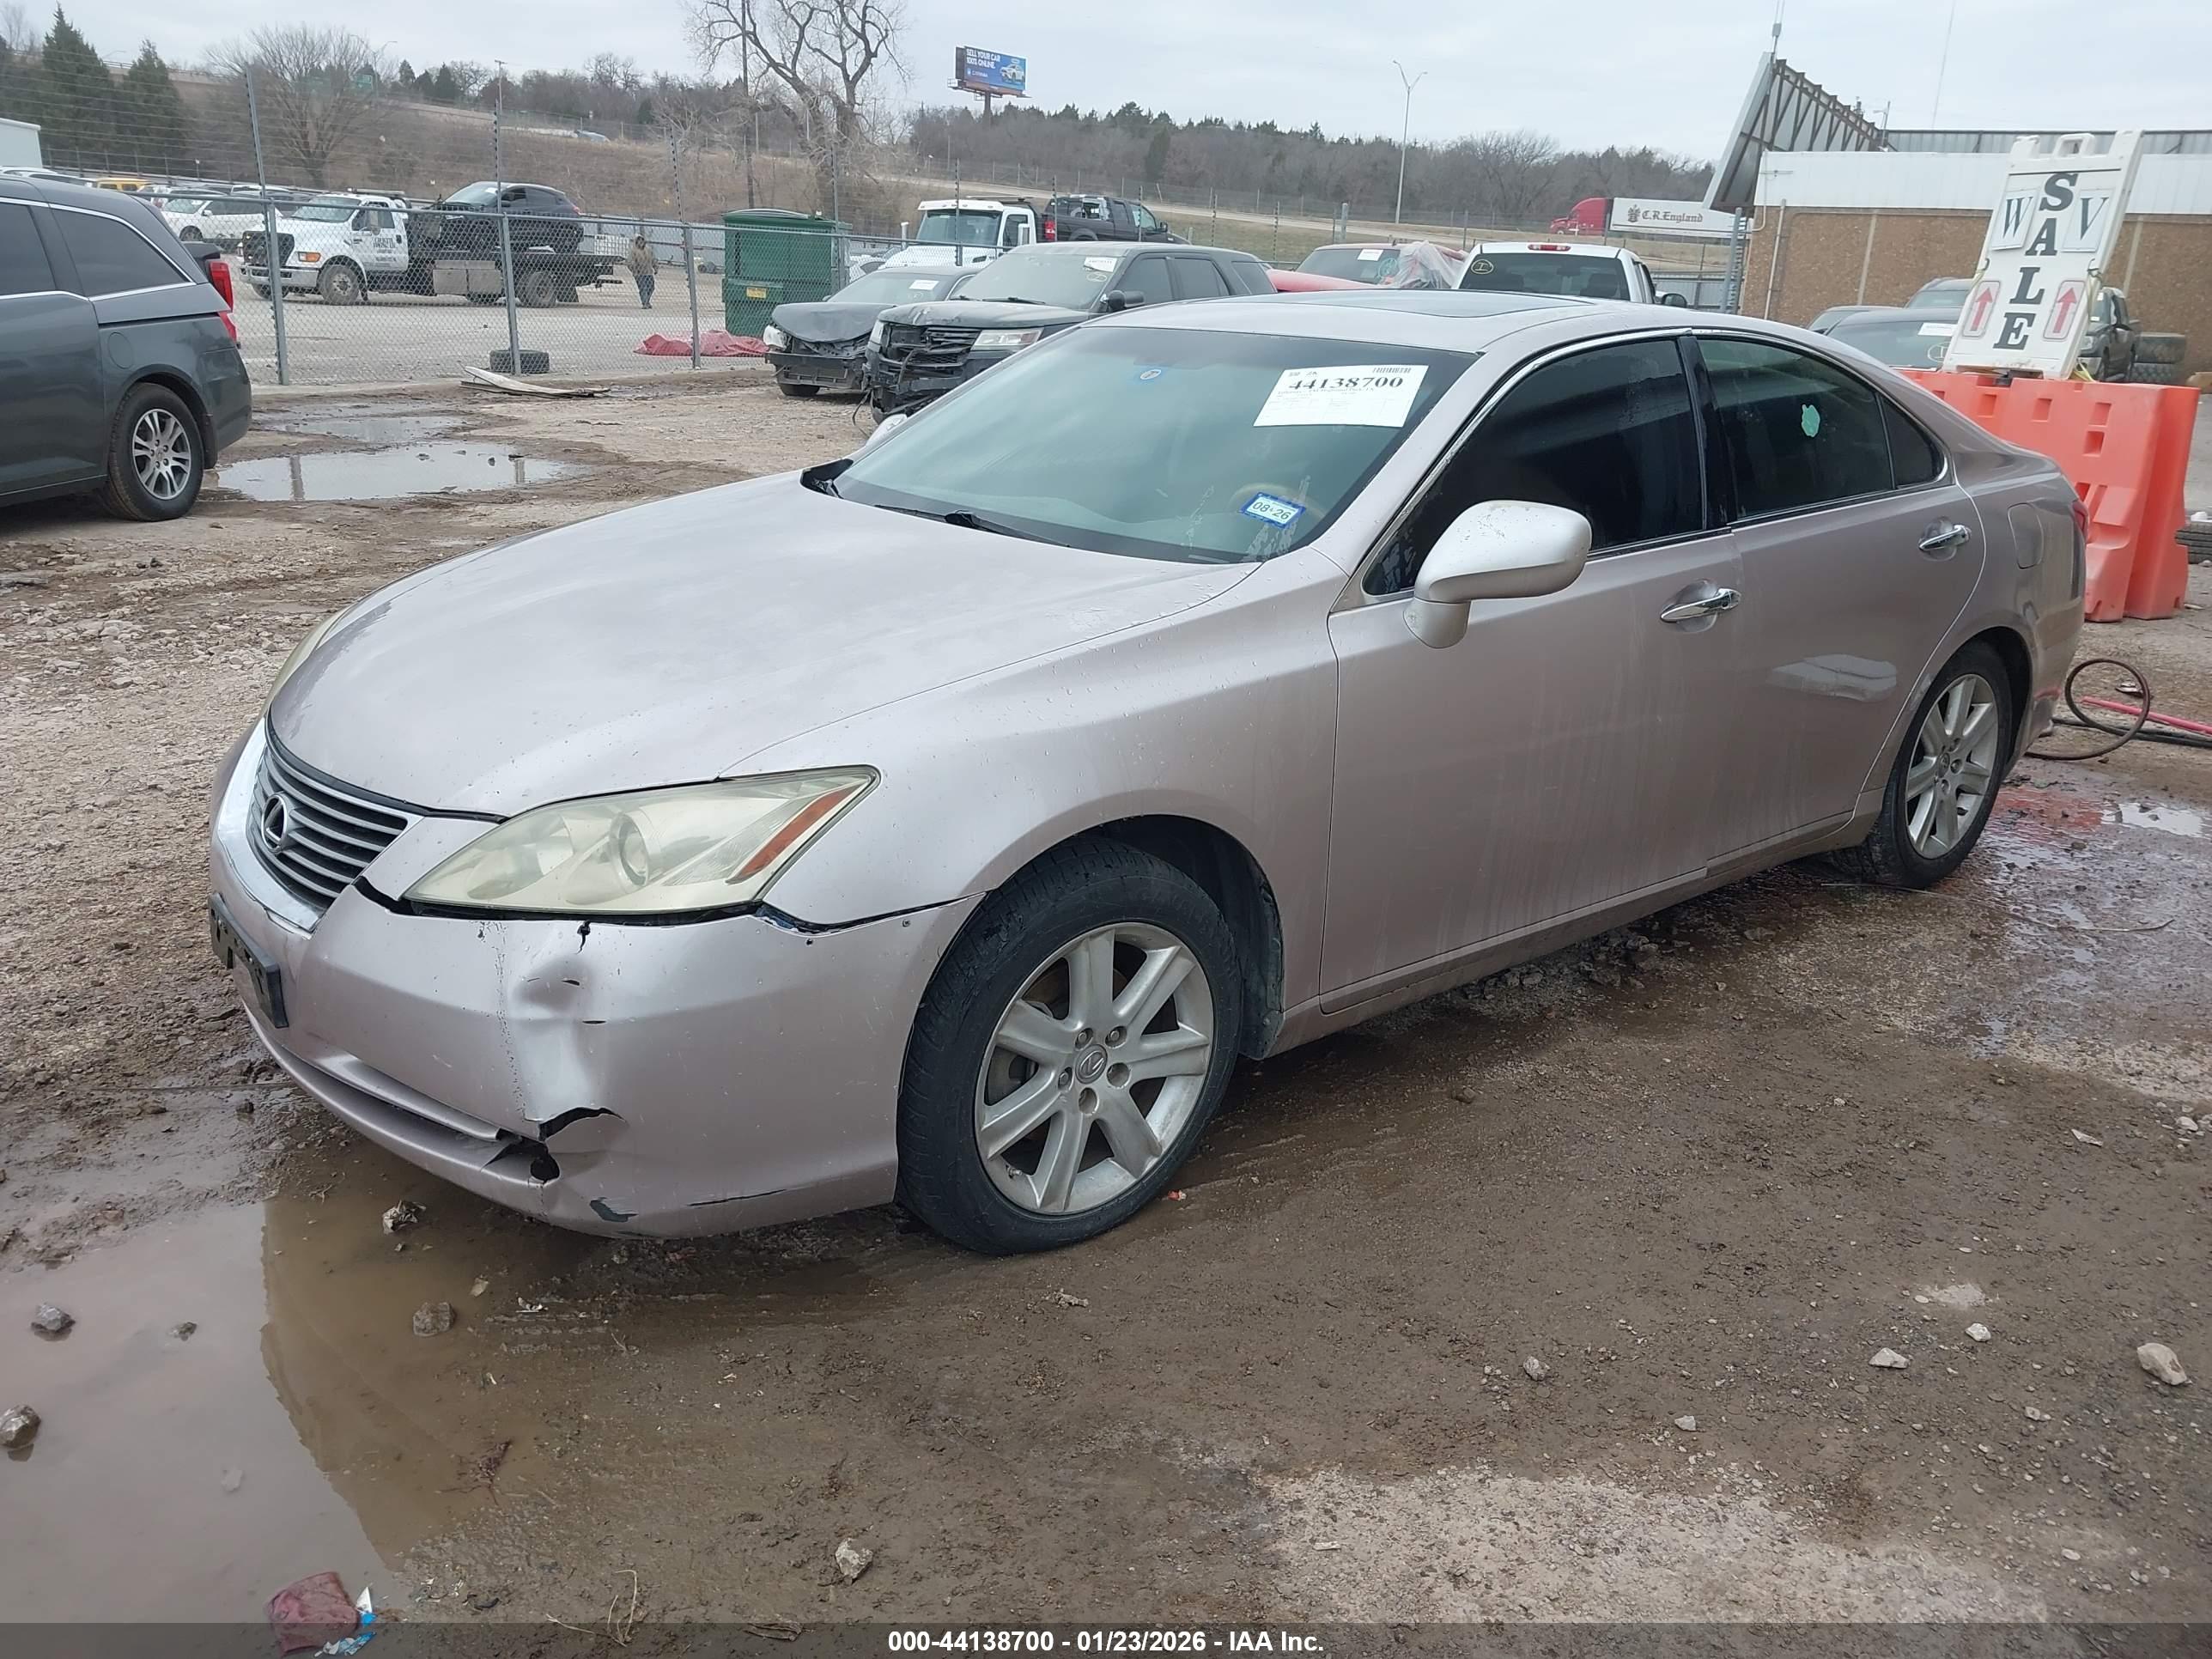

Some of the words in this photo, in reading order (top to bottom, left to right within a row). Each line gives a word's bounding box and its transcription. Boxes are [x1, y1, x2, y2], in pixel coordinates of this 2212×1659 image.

[991, 53, 1000, 62] CAR
[2002, 196, 2033, 239] W
[2080, 197, 2109, 240] V
[1288, 376, 1404, 390] 44138700
[1252, 501, 1271, 513] 08
[1272, 508, 1291, 520] 26
